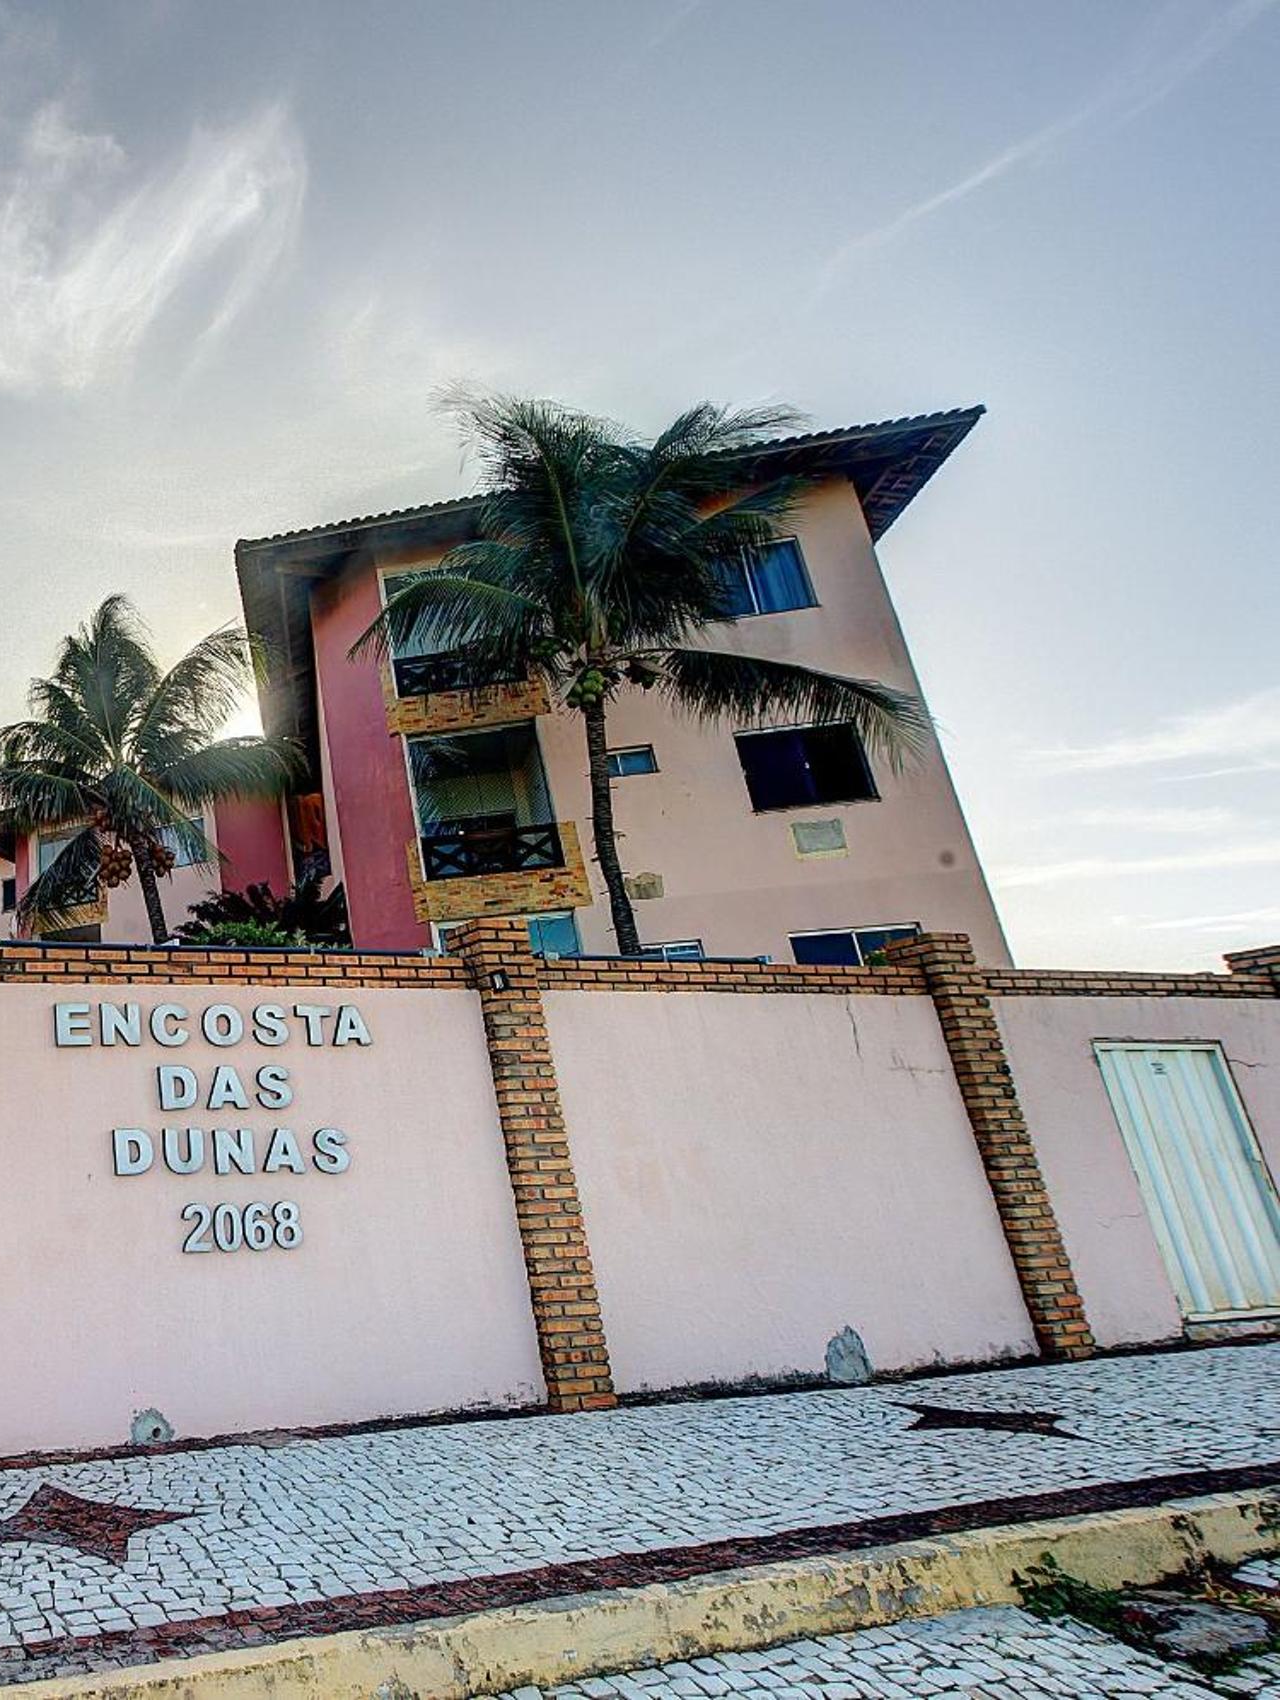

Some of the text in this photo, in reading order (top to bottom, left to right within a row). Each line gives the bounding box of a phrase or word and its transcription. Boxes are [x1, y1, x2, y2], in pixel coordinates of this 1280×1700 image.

[53, 1002, 373, 1047] ENCOSTA
[156, 1065, 294, 1111] DAS
[112, 1127, 352, 1176] DUNAS
[181, 1200, 303, 1253] 2068
